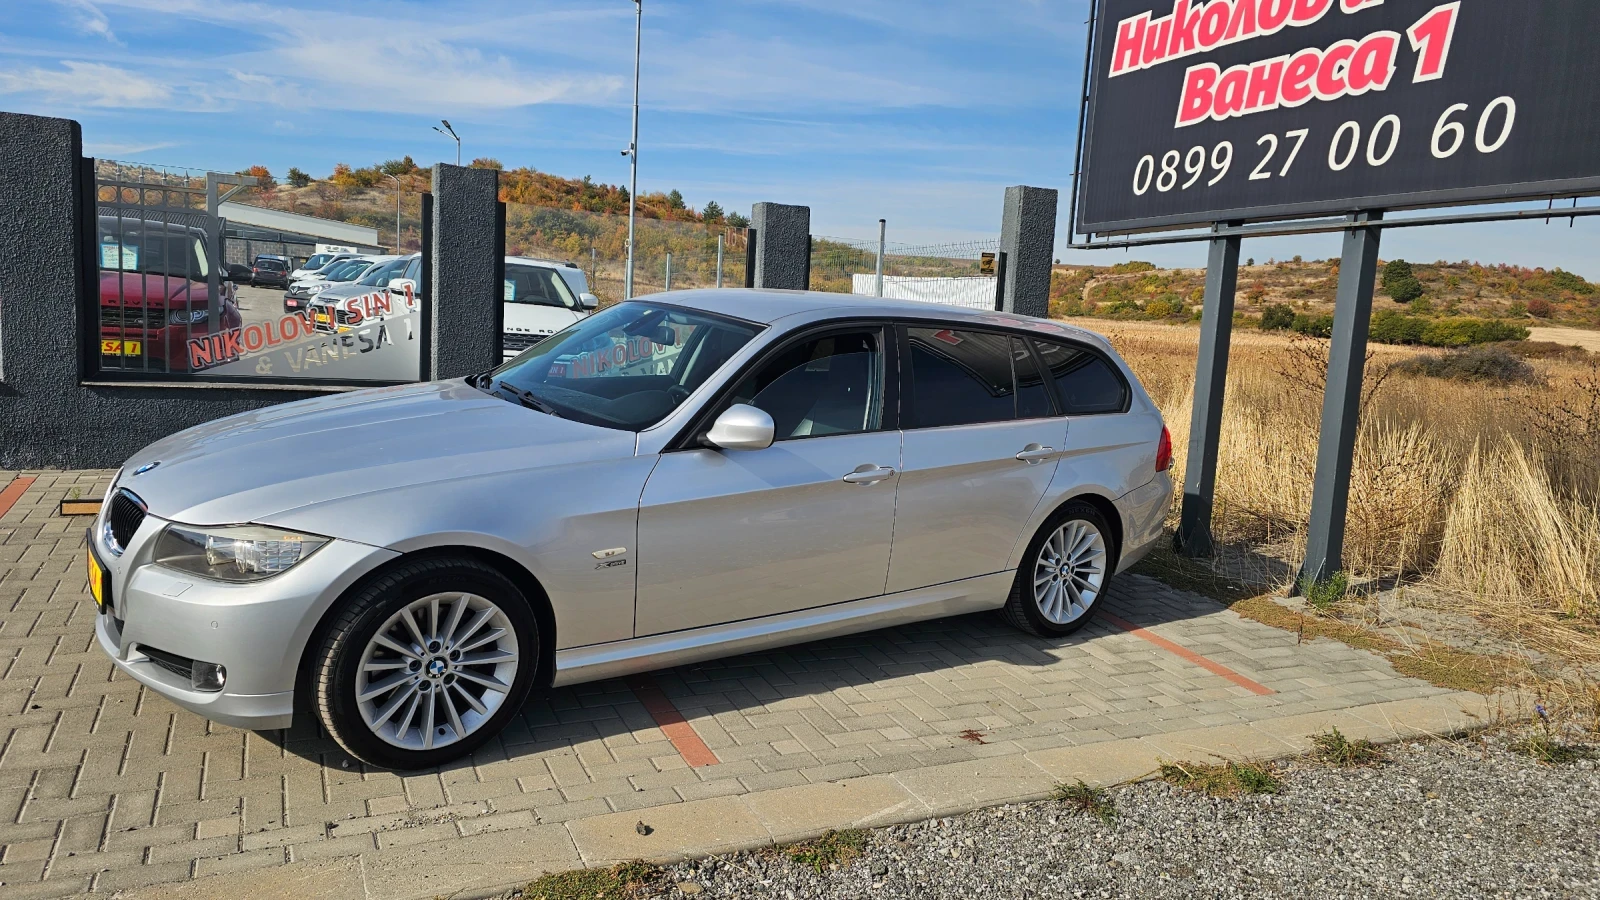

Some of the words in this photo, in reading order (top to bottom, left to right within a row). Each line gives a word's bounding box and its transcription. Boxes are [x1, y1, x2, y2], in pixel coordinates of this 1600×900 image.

[1174, 30, 1401, 128] Ванеса
[1406, 1, 1460, 83] 1
[1132, 140, 1234, 196] 0899
[1248, 128, 1309, 180] 27
[1328, 114, 1401, 171] 00
[1430, 96, 1516, 159] 60
[103, 342, 122, 352] SA
[188, 308, 316, 368] NIKOLOV
[346, 289, 392, 323] SIN
[404, 284, 414, 307] 1
[255, 356, 273, 375] &
[284, 324, 395, 373] VANESA
[403, 318, 414, 340] 1
